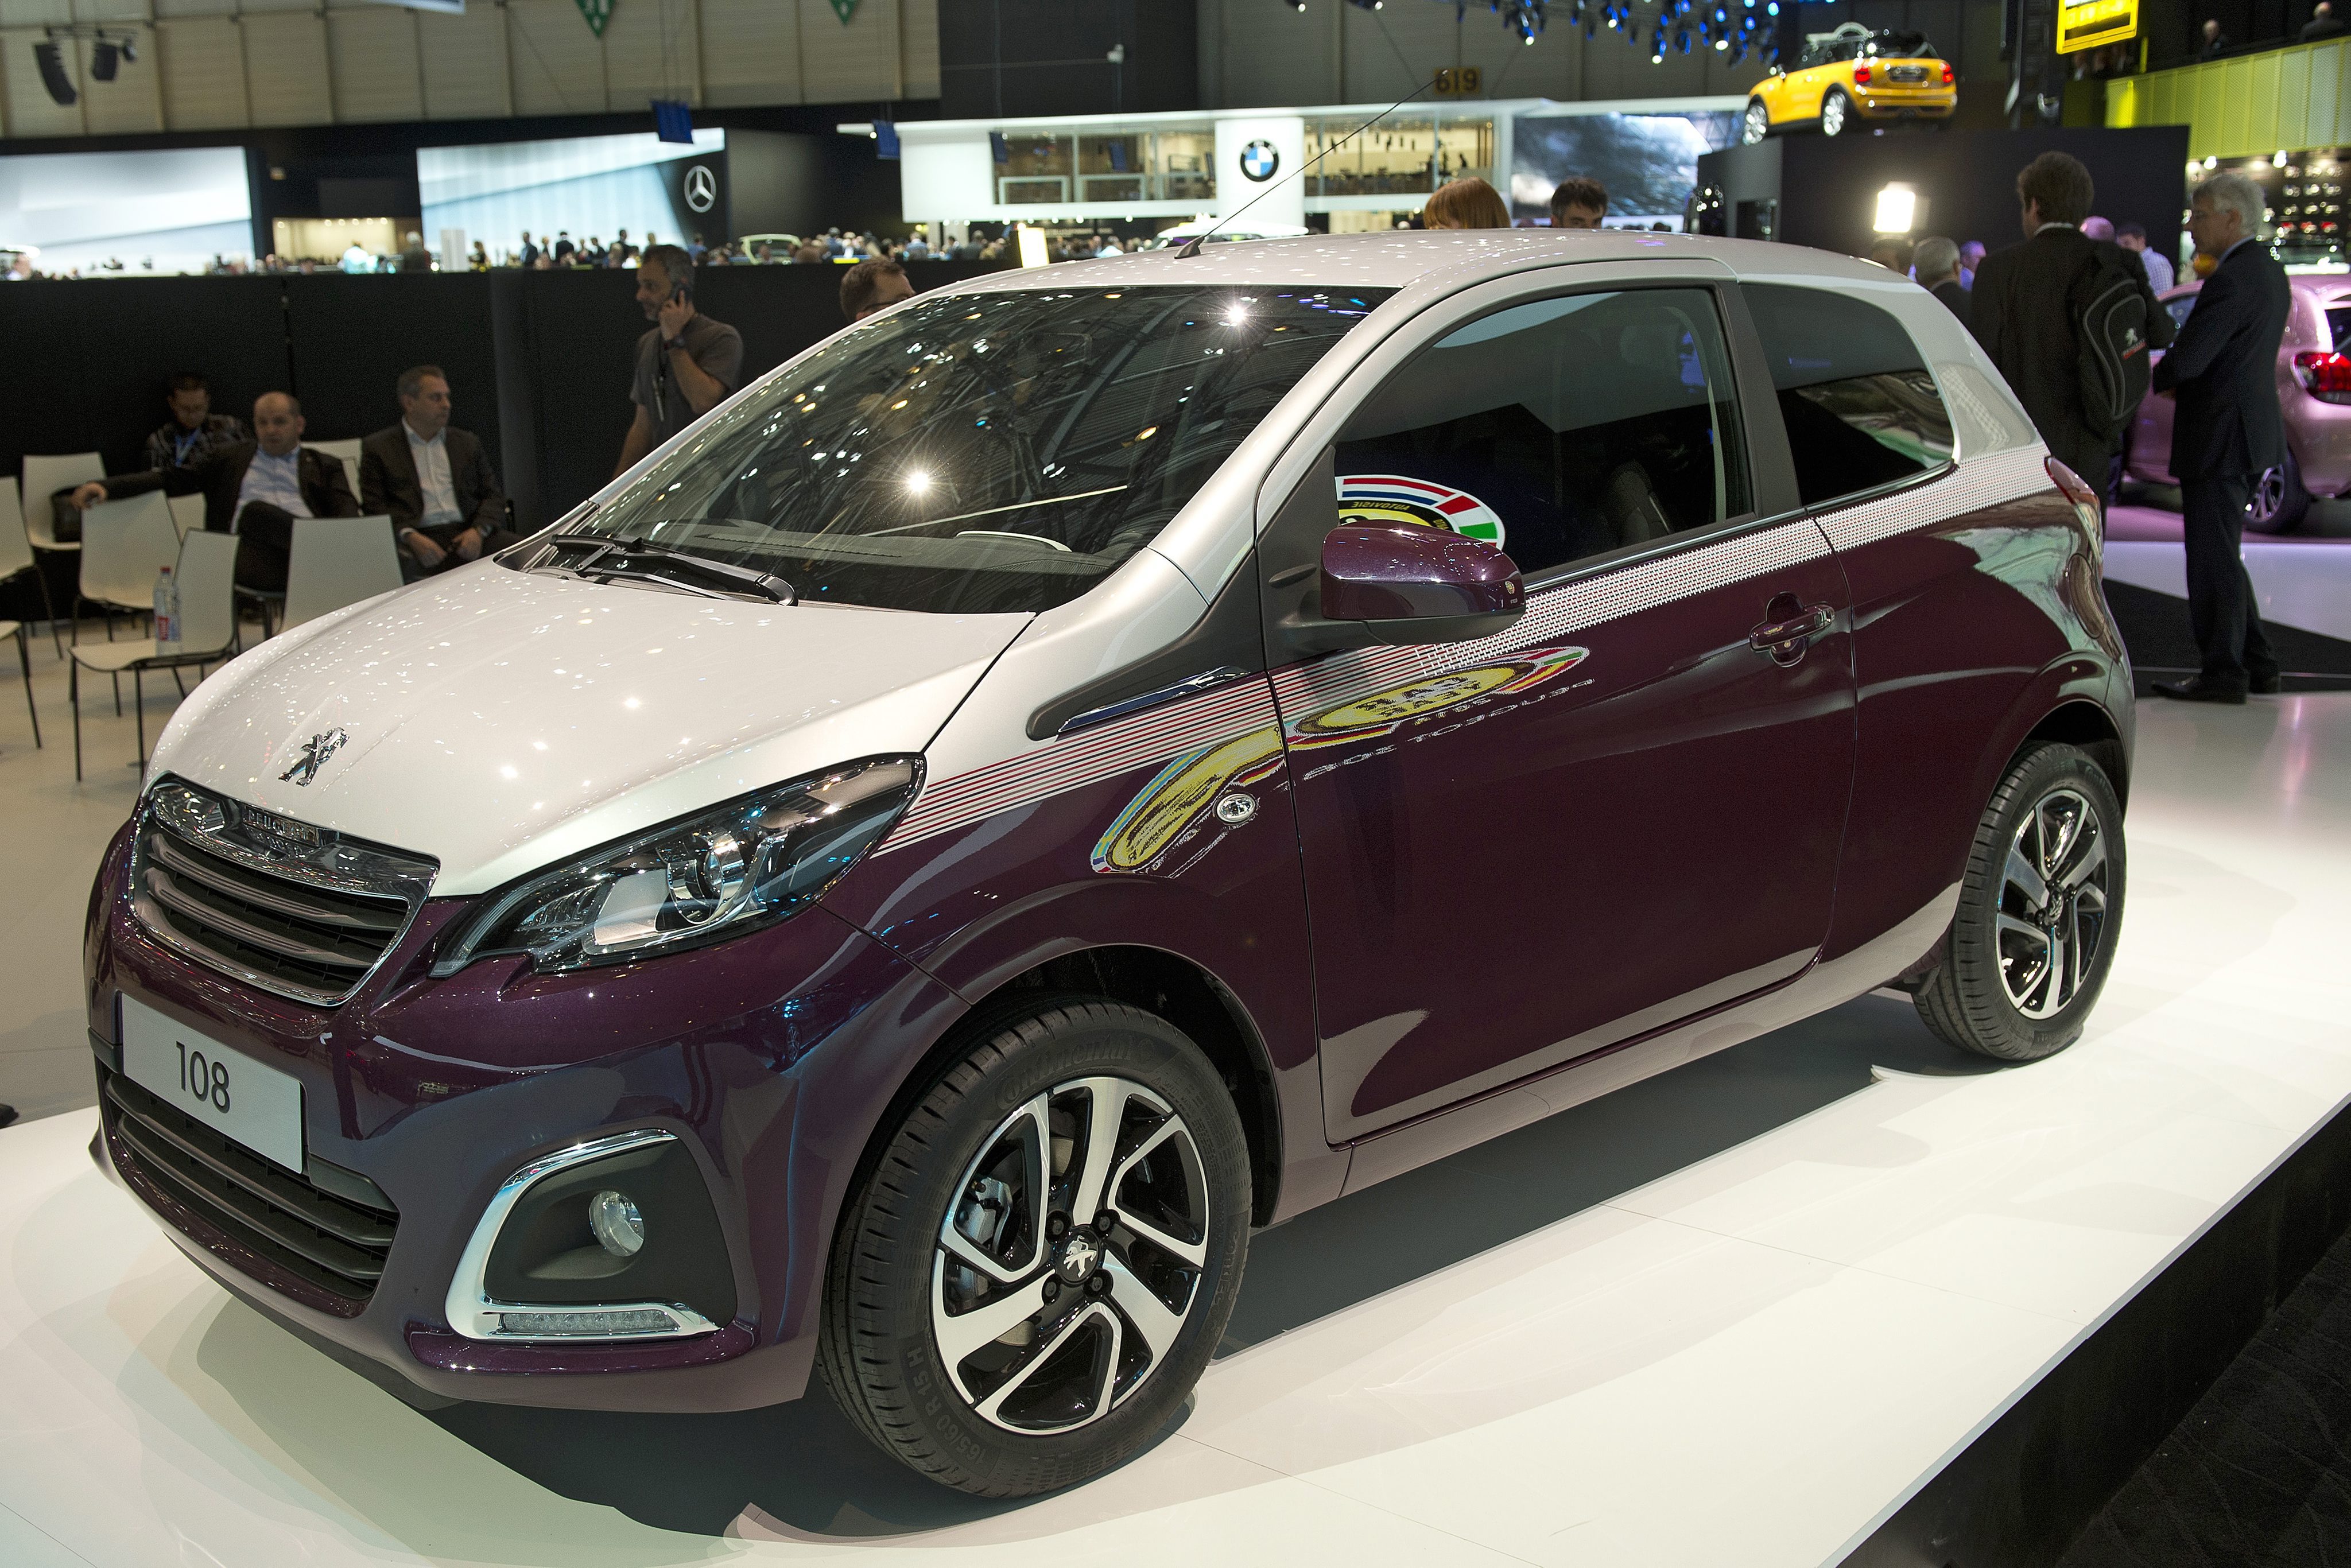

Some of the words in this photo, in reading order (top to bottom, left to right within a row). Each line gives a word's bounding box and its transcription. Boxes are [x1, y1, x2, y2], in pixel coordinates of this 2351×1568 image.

[1436, 69, 1477, 92] 619
[176, 1041, 231, 1114] 108
[906, 1346, 924, 1368] H
[912, 1369, 933, 1397] 15
[924, 1395, 942, 1418] R
[933, 1413, 986, 1465] 165/60
